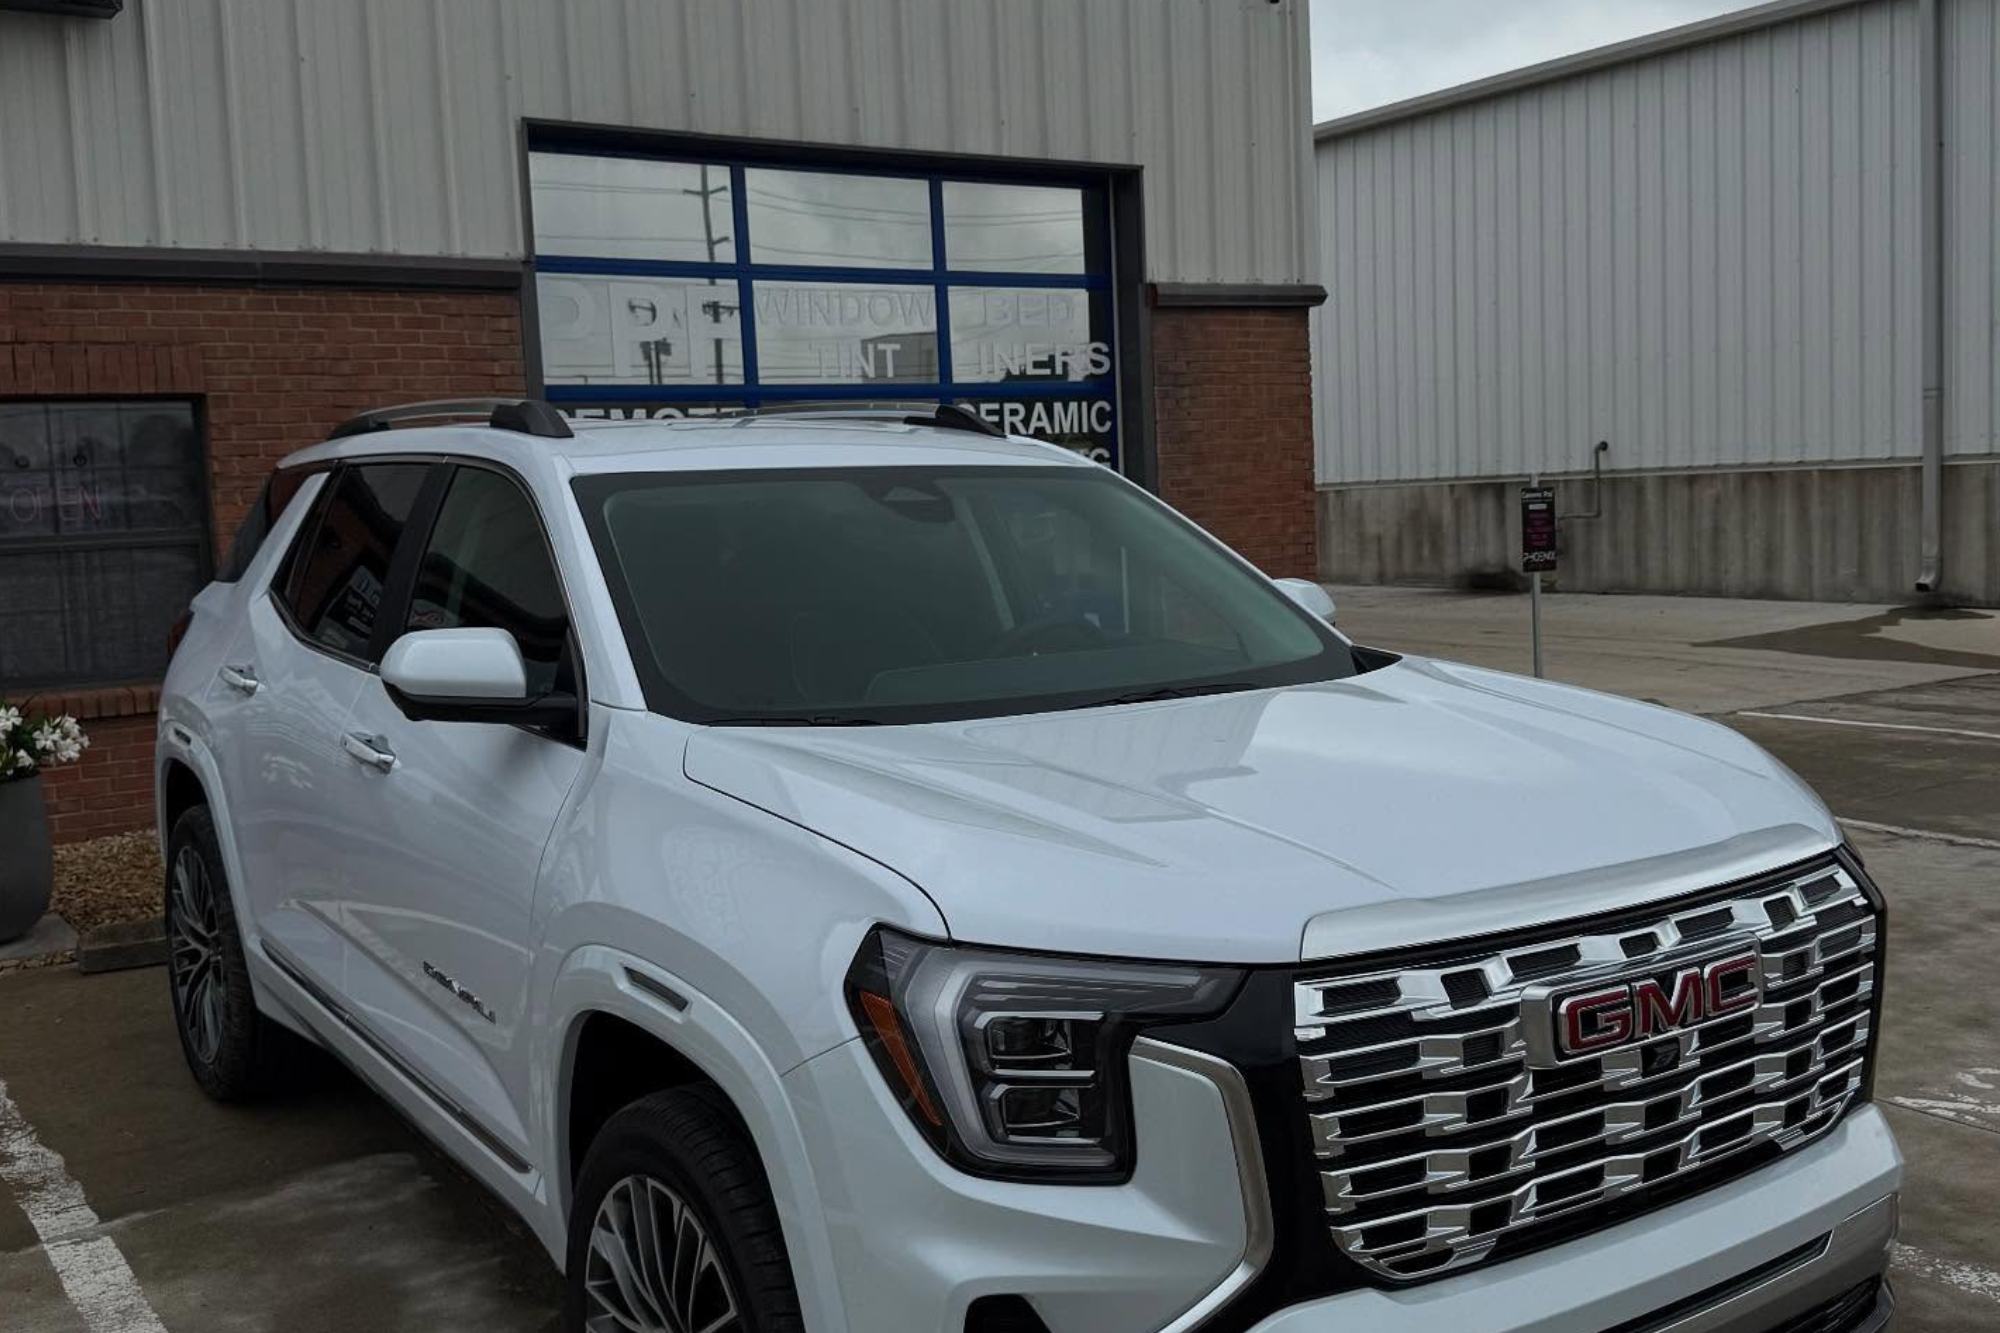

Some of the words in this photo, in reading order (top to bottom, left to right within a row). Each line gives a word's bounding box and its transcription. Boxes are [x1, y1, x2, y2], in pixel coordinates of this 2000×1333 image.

[754, 287, 935, 326] WINDOW
[984, 292, 1073, 330] BED
[808, 341, 900, 379] TINT
[957, 400, 1112, 436] ERAMIC
[1558, 951, 1758, 1054] GMC
